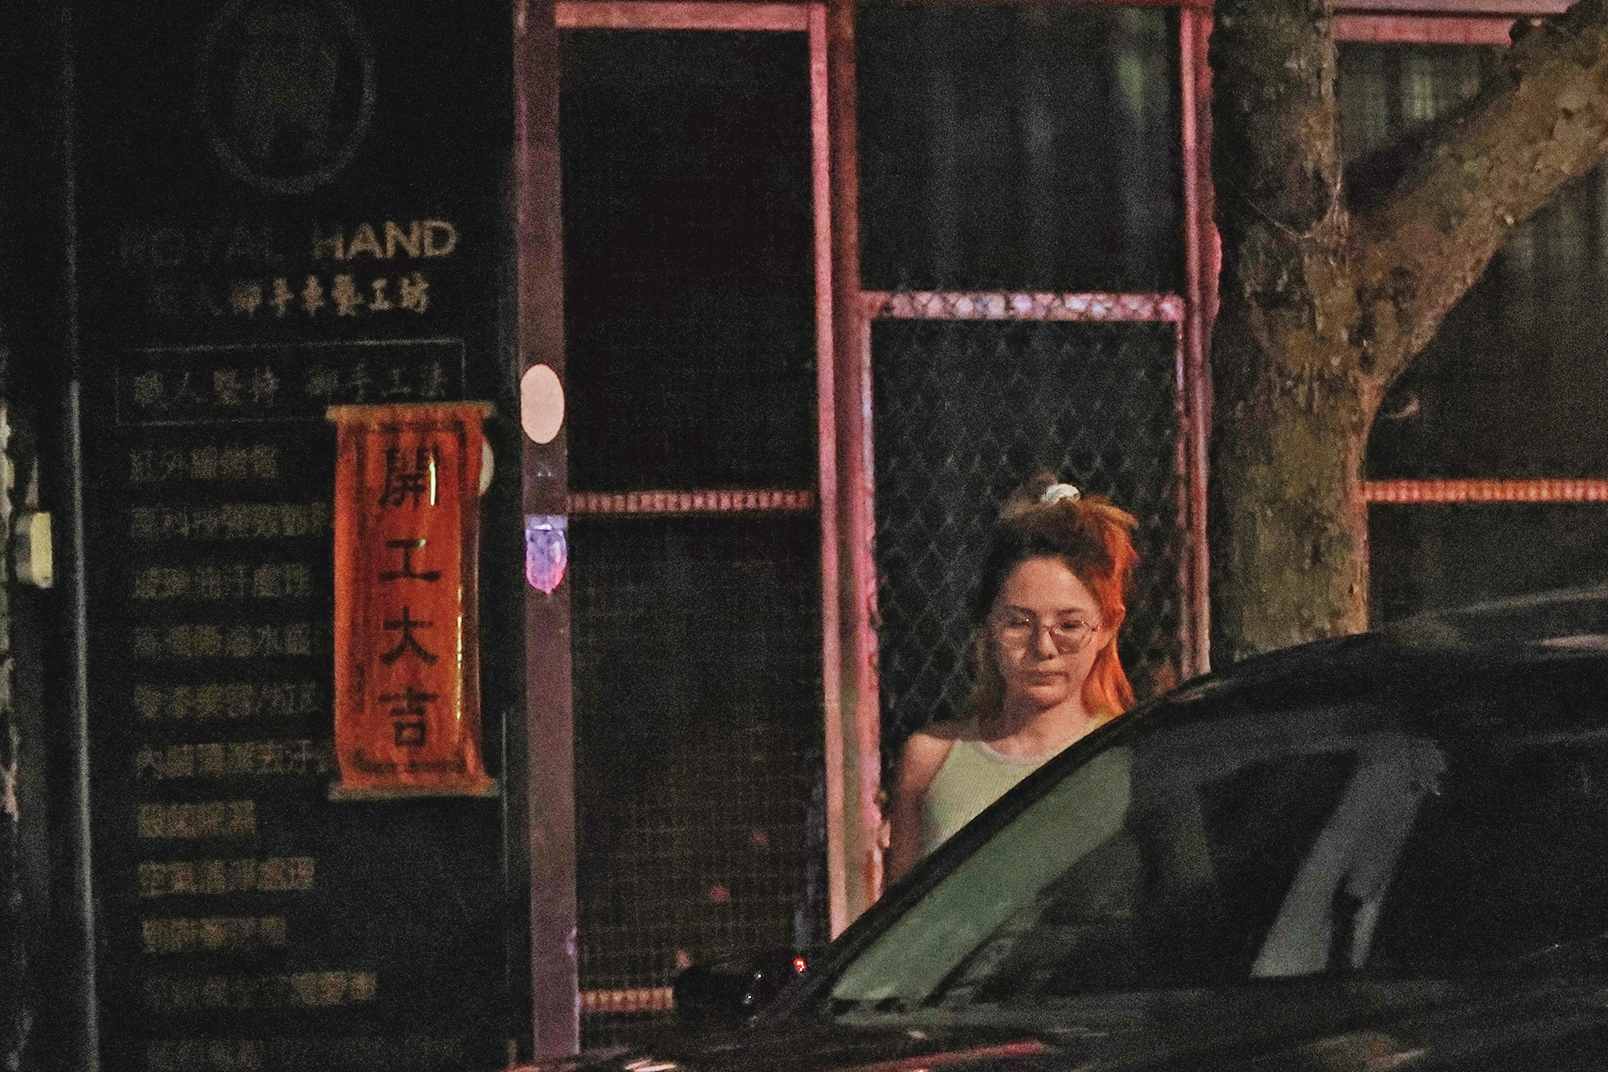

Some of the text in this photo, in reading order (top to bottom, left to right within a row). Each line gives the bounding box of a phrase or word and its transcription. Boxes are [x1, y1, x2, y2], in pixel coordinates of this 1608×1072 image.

[311, 217, 459, 262] HAND
[378, 443, 443, 750] 開工大吉
